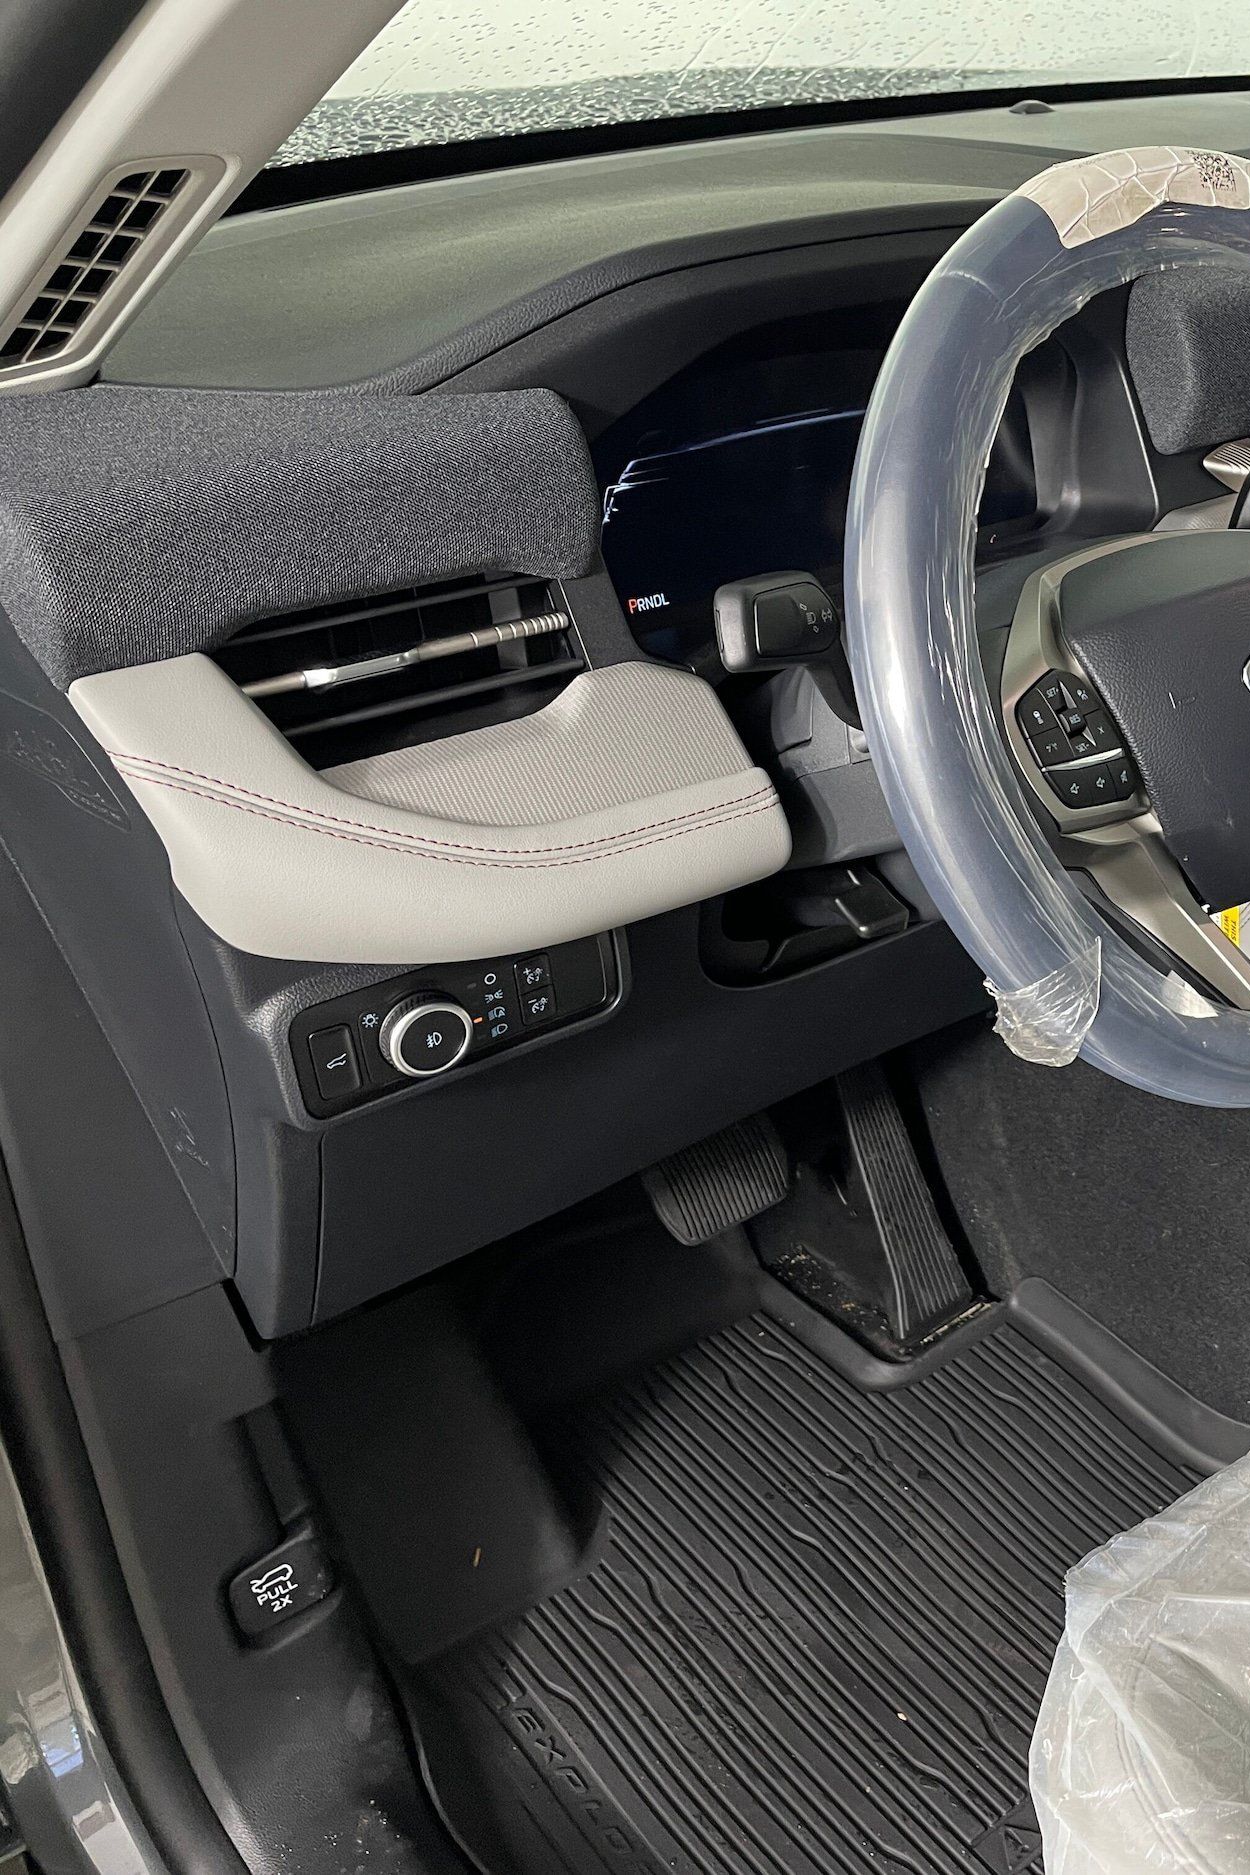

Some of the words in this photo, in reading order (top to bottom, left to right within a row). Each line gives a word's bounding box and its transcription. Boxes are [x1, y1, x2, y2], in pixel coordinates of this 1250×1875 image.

[628, 592, 670, 614] PRNDL
[256, 1580, 299, 1606] PULL
[270, 1594, 293, 1612] 2X
[511, 1706, 648, 1875] EXPLO
